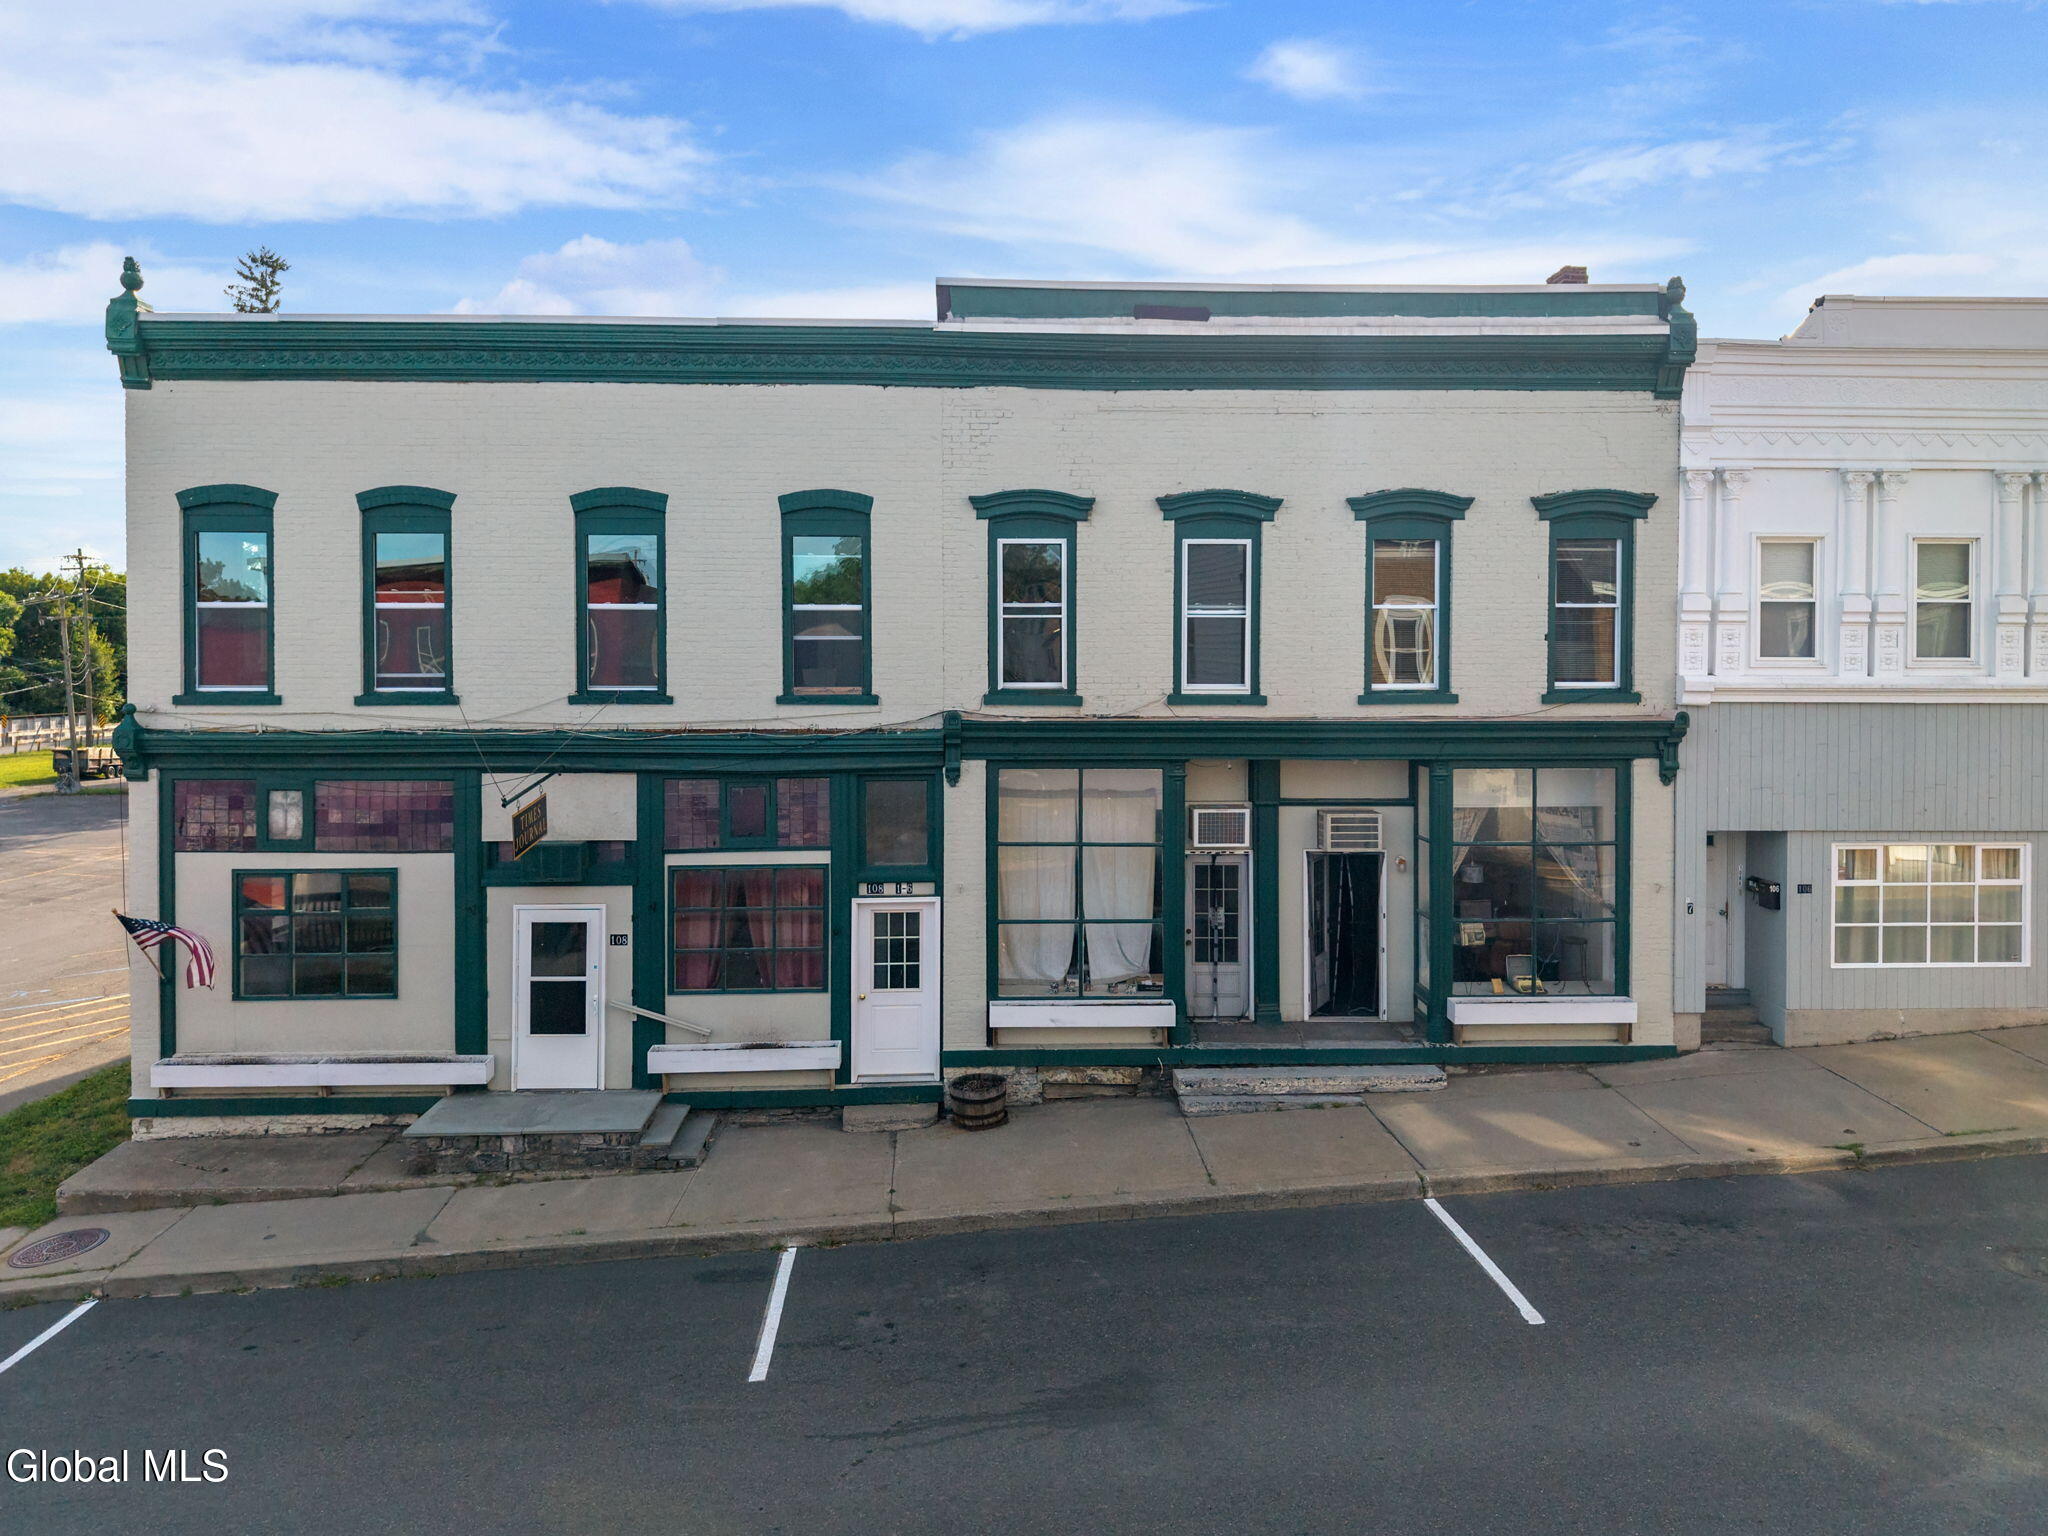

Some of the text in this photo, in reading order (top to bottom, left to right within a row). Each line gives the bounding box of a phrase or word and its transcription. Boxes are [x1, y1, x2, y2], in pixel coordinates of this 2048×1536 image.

[521, 805, 542, 830] TIMES
[514, 818, 547, 852] JOURNAL
[867, 883, 884, 894] 108
[1769, 884, 1780, 893] 106
[1687, 903, 1693, 914] 7
[611, 935, 628, 945] 108
